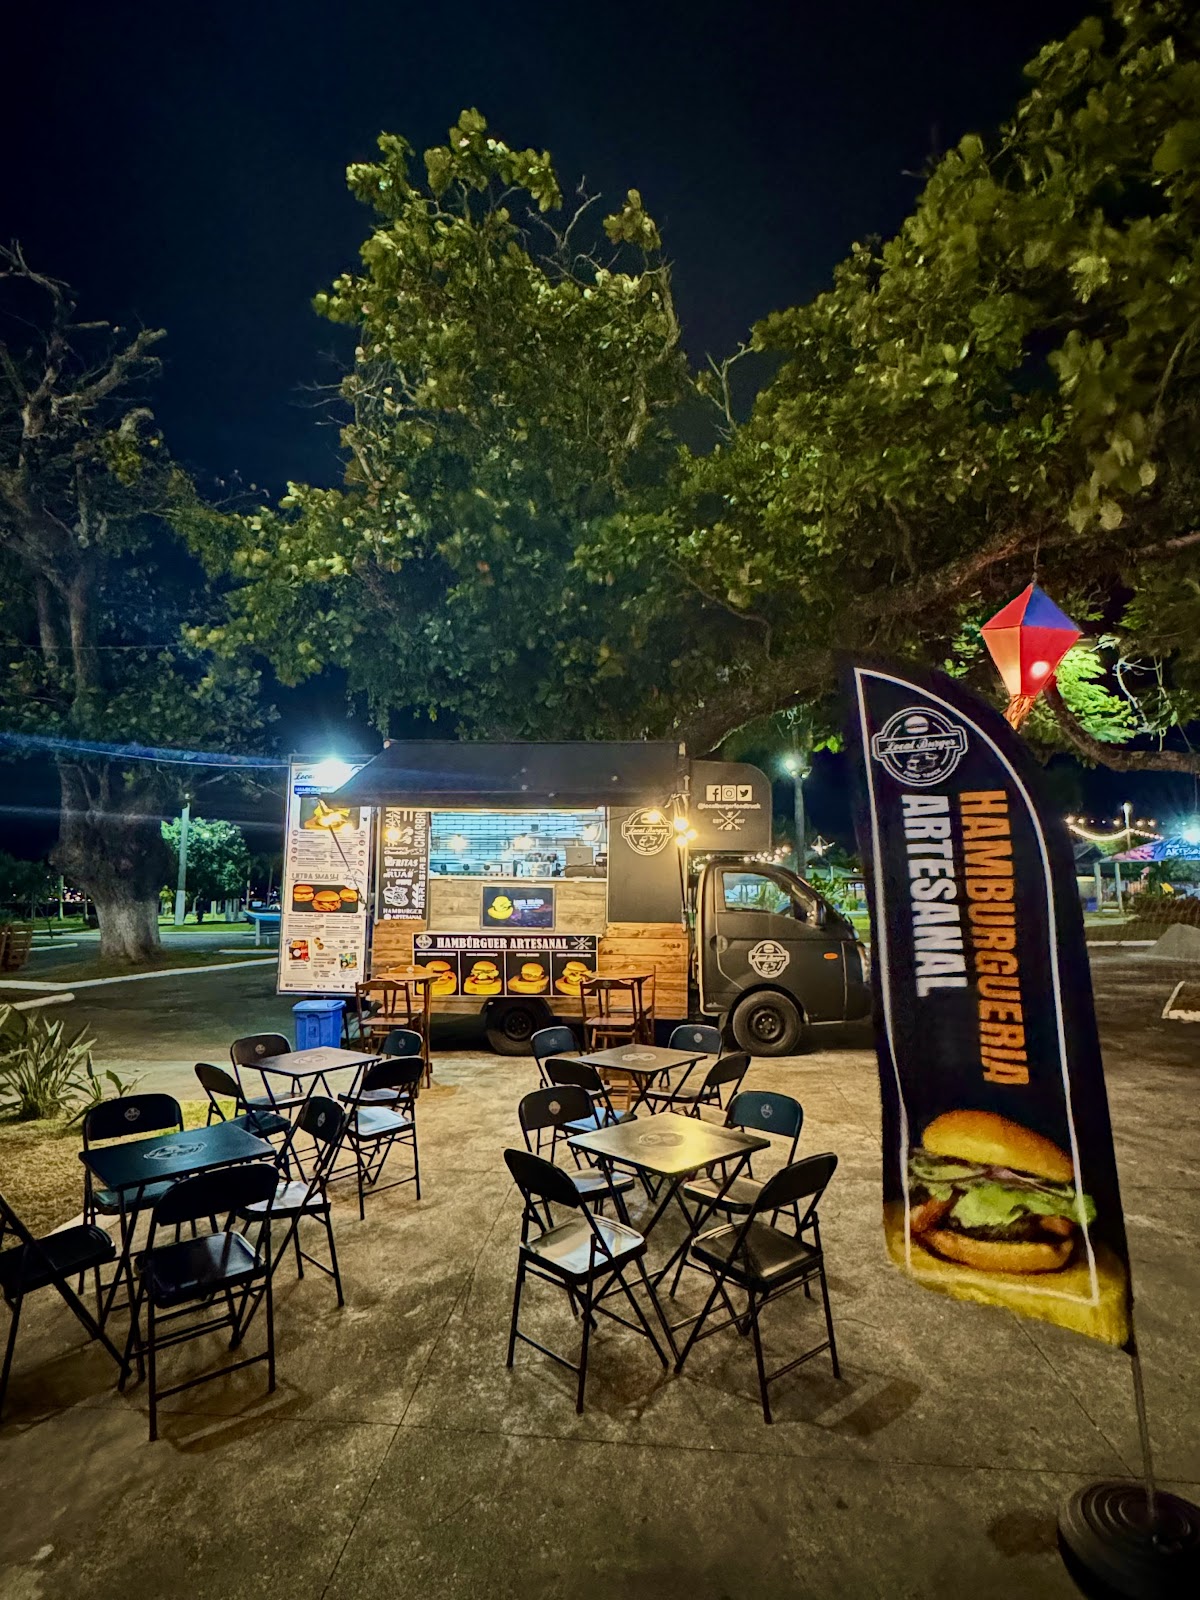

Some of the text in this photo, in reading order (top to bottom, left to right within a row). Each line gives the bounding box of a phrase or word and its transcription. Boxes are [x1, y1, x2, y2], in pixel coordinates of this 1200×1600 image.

[884, 740, 916, 752] Local
[436, 936, 569, 949] HAMBÚRGUER ARTESANAL
[901, 794, 968, 997] ARTESANAL
[959, 790, 1029, 1084] HAMBURGUERIA
